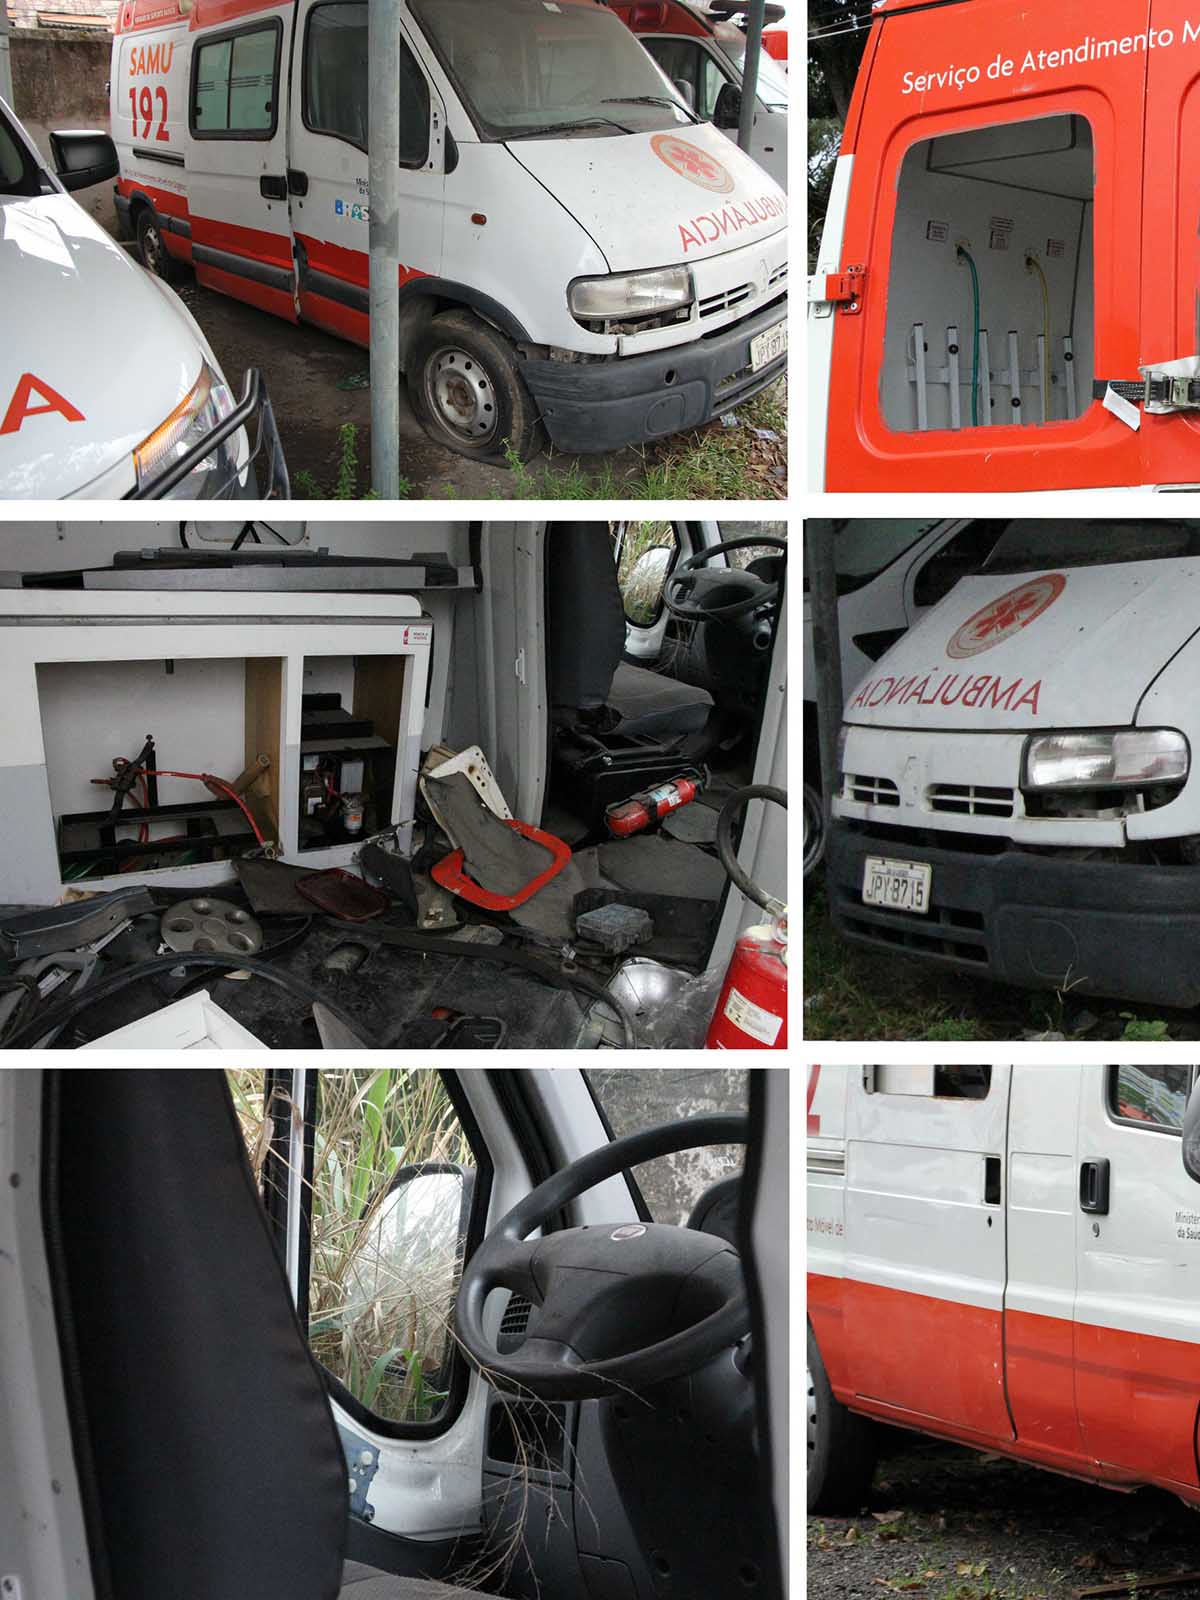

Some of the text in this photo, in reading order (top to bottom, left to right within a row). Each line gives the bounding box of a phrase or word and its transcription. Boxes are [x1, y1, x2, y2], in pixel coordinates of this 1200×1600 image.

[129, 41, 175, 76] SAMU
[901, 64, 980, 94] Serviço
[986, 53, 1014, 80] de
[1020, 27, 1174, 74] Atendimento
[129, 86, 170, 141] 192
